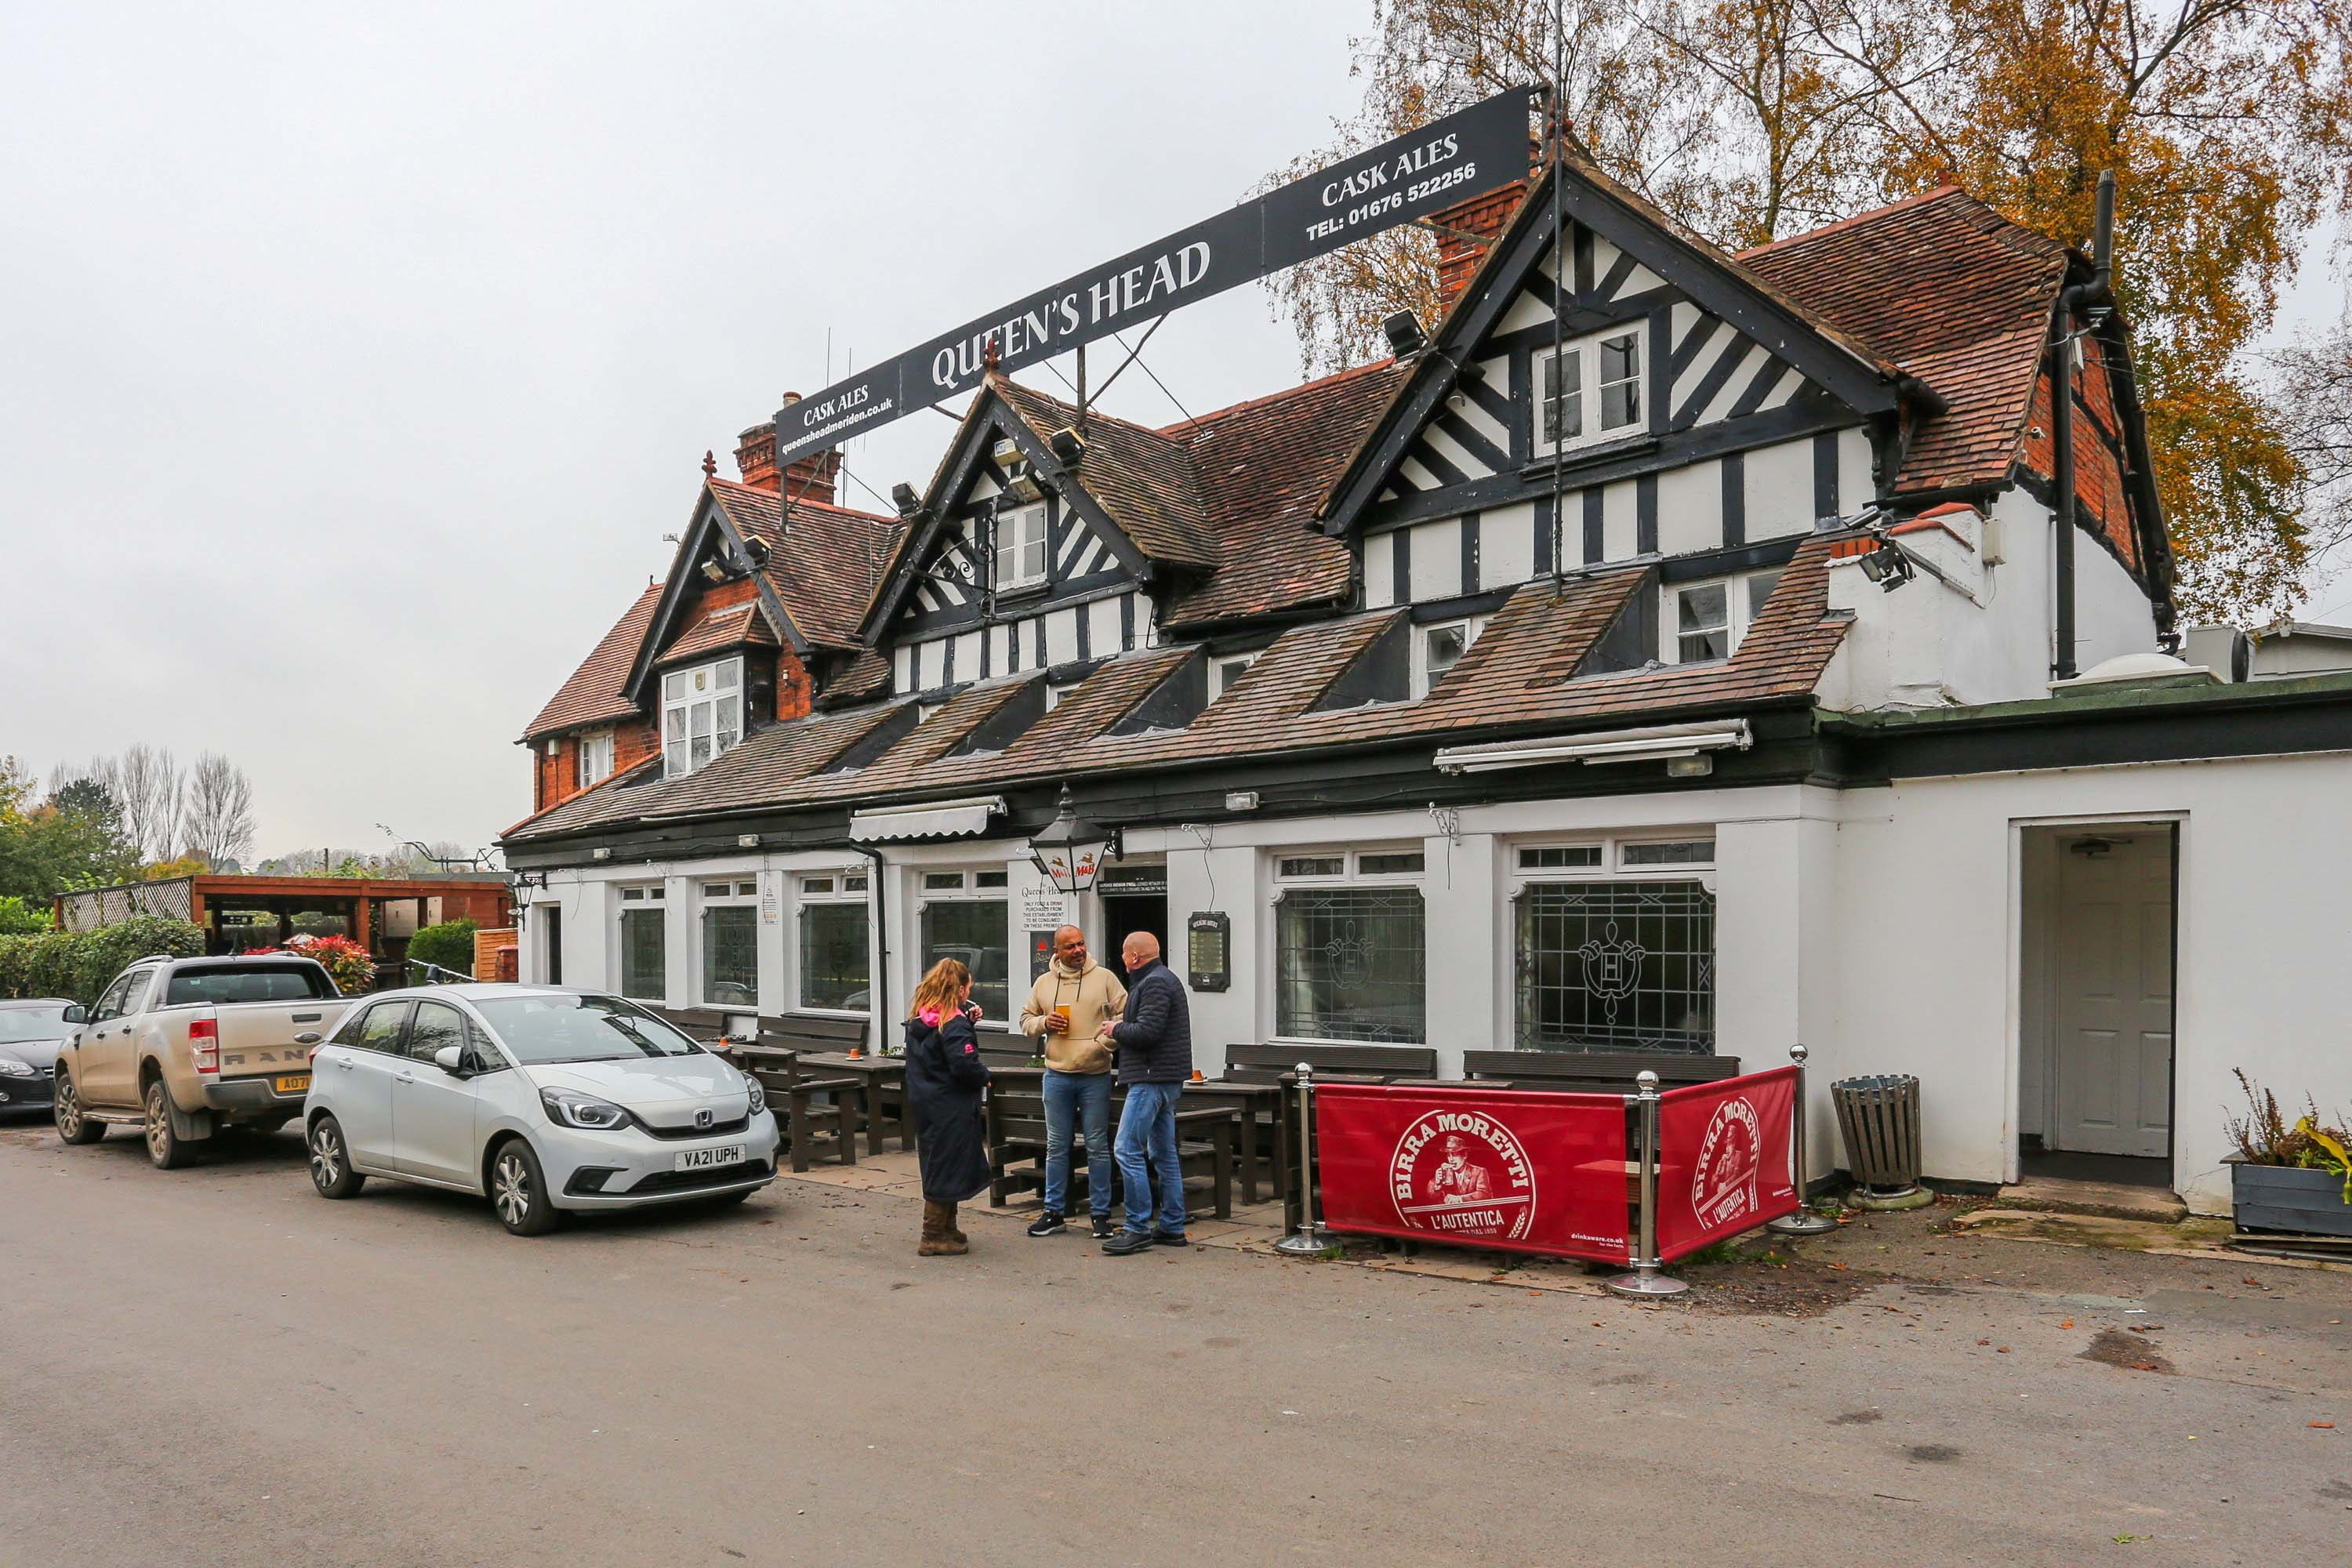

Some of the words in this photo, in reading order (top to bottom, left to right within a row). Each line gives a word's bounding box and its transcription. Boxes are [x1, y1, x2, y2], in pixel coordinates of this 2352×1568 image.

[1322, 161, 1388, 207] CASK
[1392, 132, 1458, 181] ALES
[1306, 216, 1345, 241] TEL:
[1348, 191, 1403, 226] 01676
[1407, 162, 1476, 202] 522256
[931, 292, 1080, 390] QUEEN'S
[1087, 241, 1211, 325] HEAD
[782, 397, 893, 456] queensheadmeriden.co.uk
[804, 398, 836, 426] CASK
[837, 384, 869, 412] ALES
[1075, 863, 1095, 877] M&B
[684, 1150, 713, 1167] VA21
[715, 1146, 739, 1163] UPH
[1396, 1123, 1437, 1200] BIRRA
[1436, 1112, 1530, 1189] MORETTI
[1695, 1117, 1725, 1202] BIRRA
[1724, 1100, 1759, 1163] MORETTI
[1430, 1210, 1504, 1230] L'AUTENTICA
[1712, 1186, 1747, 1225] L'AUTENTICA
[1570, 1232, 1624, 1244] drinkaware.co.uk
